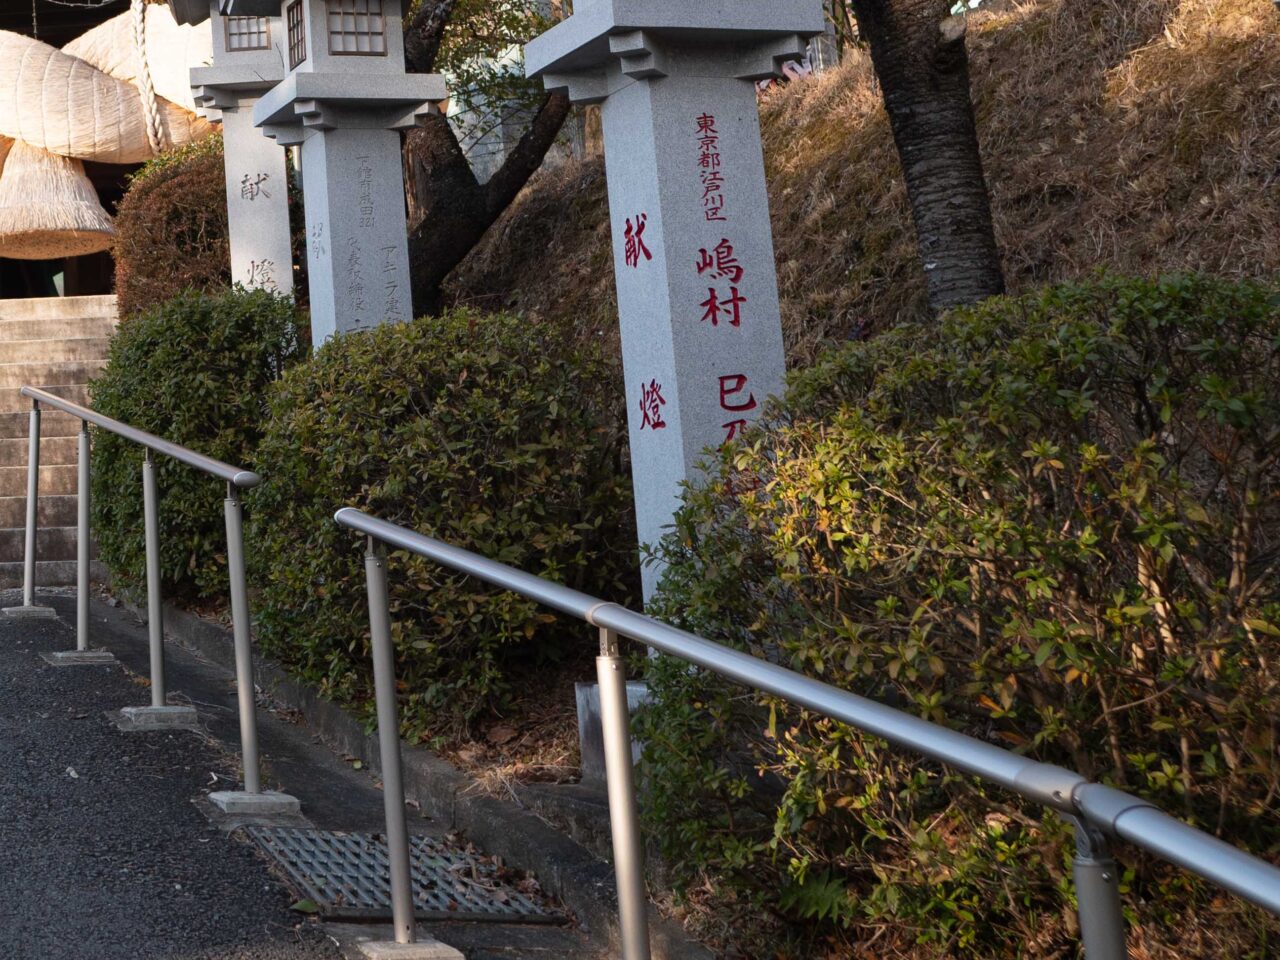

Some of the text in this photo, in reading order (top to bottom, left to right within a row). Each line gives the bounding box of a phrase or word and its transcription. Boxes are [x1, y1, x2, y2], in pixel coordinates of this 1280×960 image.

[695, 112, 727, 221] 東京都江戸川区
